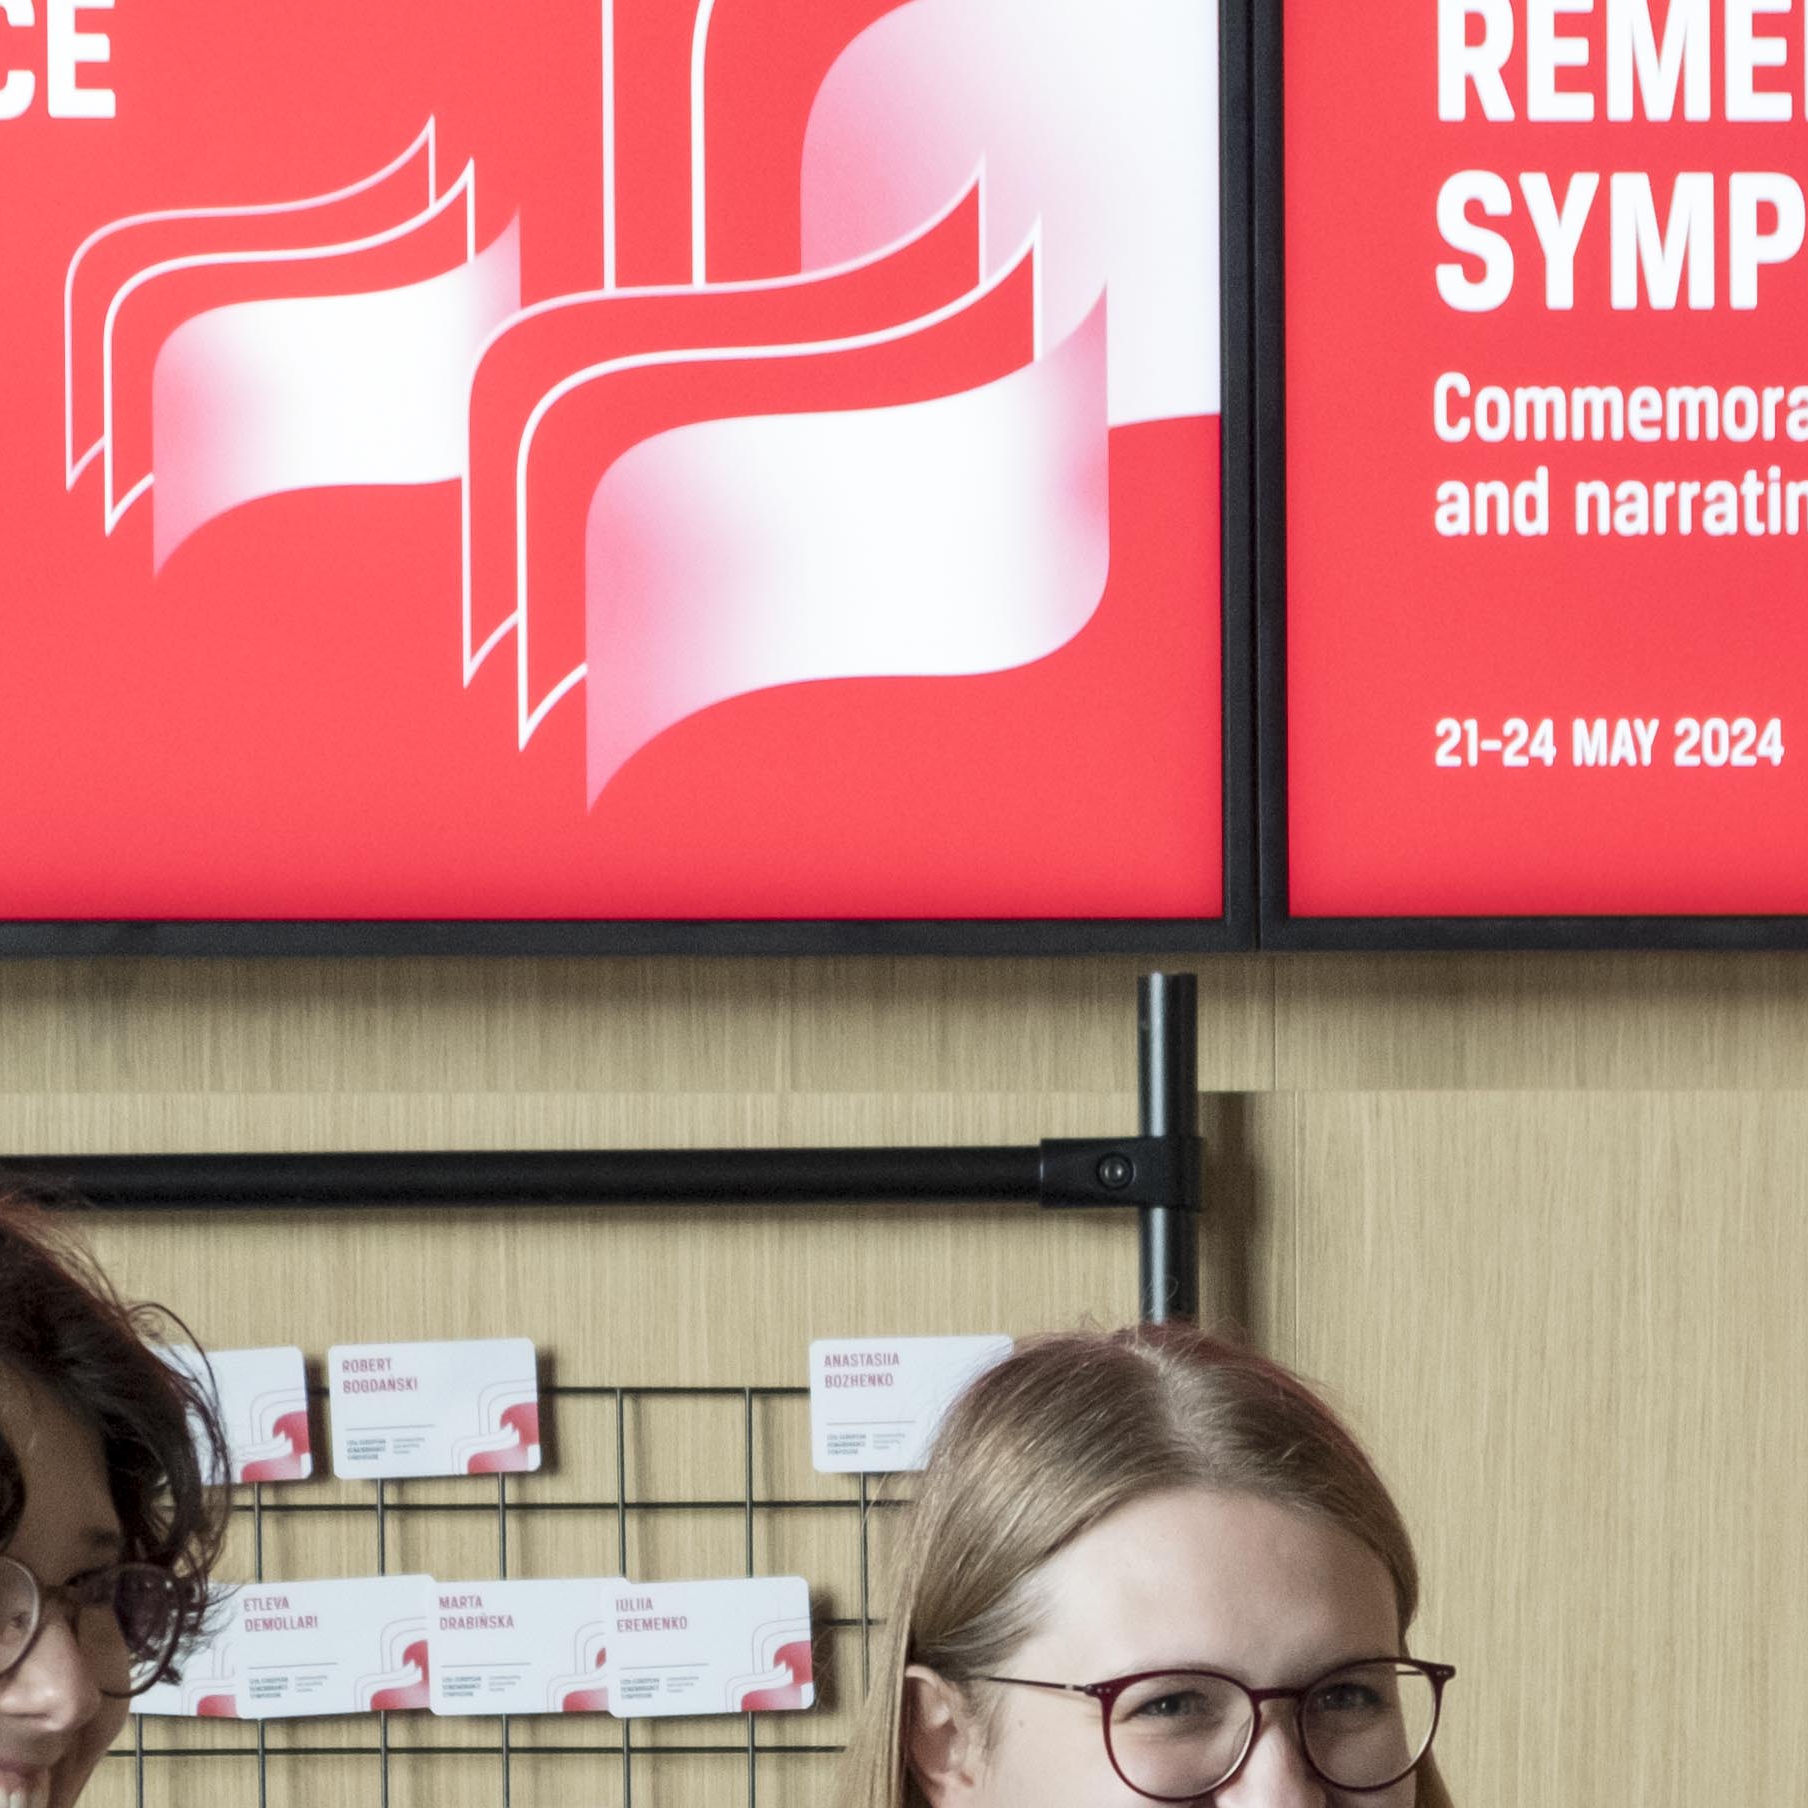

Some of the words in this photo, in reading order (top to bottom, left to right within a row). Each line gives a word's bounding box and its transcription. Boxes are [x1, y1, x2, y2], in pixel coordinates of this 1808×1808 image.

[1434, 465, 1550, 537] and
[1571, 717, 1660, 767] MAY
[1673, 716, 1785, 767] 2024
[342, 1357, 392, 1374] ROBERT
[824, 1352, 900, 1368] ANASTASIIA
[342, 1376, 418, 1394] BOGDAŃSKI
[824, 1372, 894, 1389] BOZHENKO
[243, 1596, 290, 1612] ETLEVA
[438, 1595, 483, 1610] MARTA
[615, 1597, 654, 1613] IULIIA
[244, 1615, 318, 1632] DEMOLLARI
[439, 1613, 515, 1631] DRABIŃSKA
[616, 1615, 688, 1633] EREMENKO
